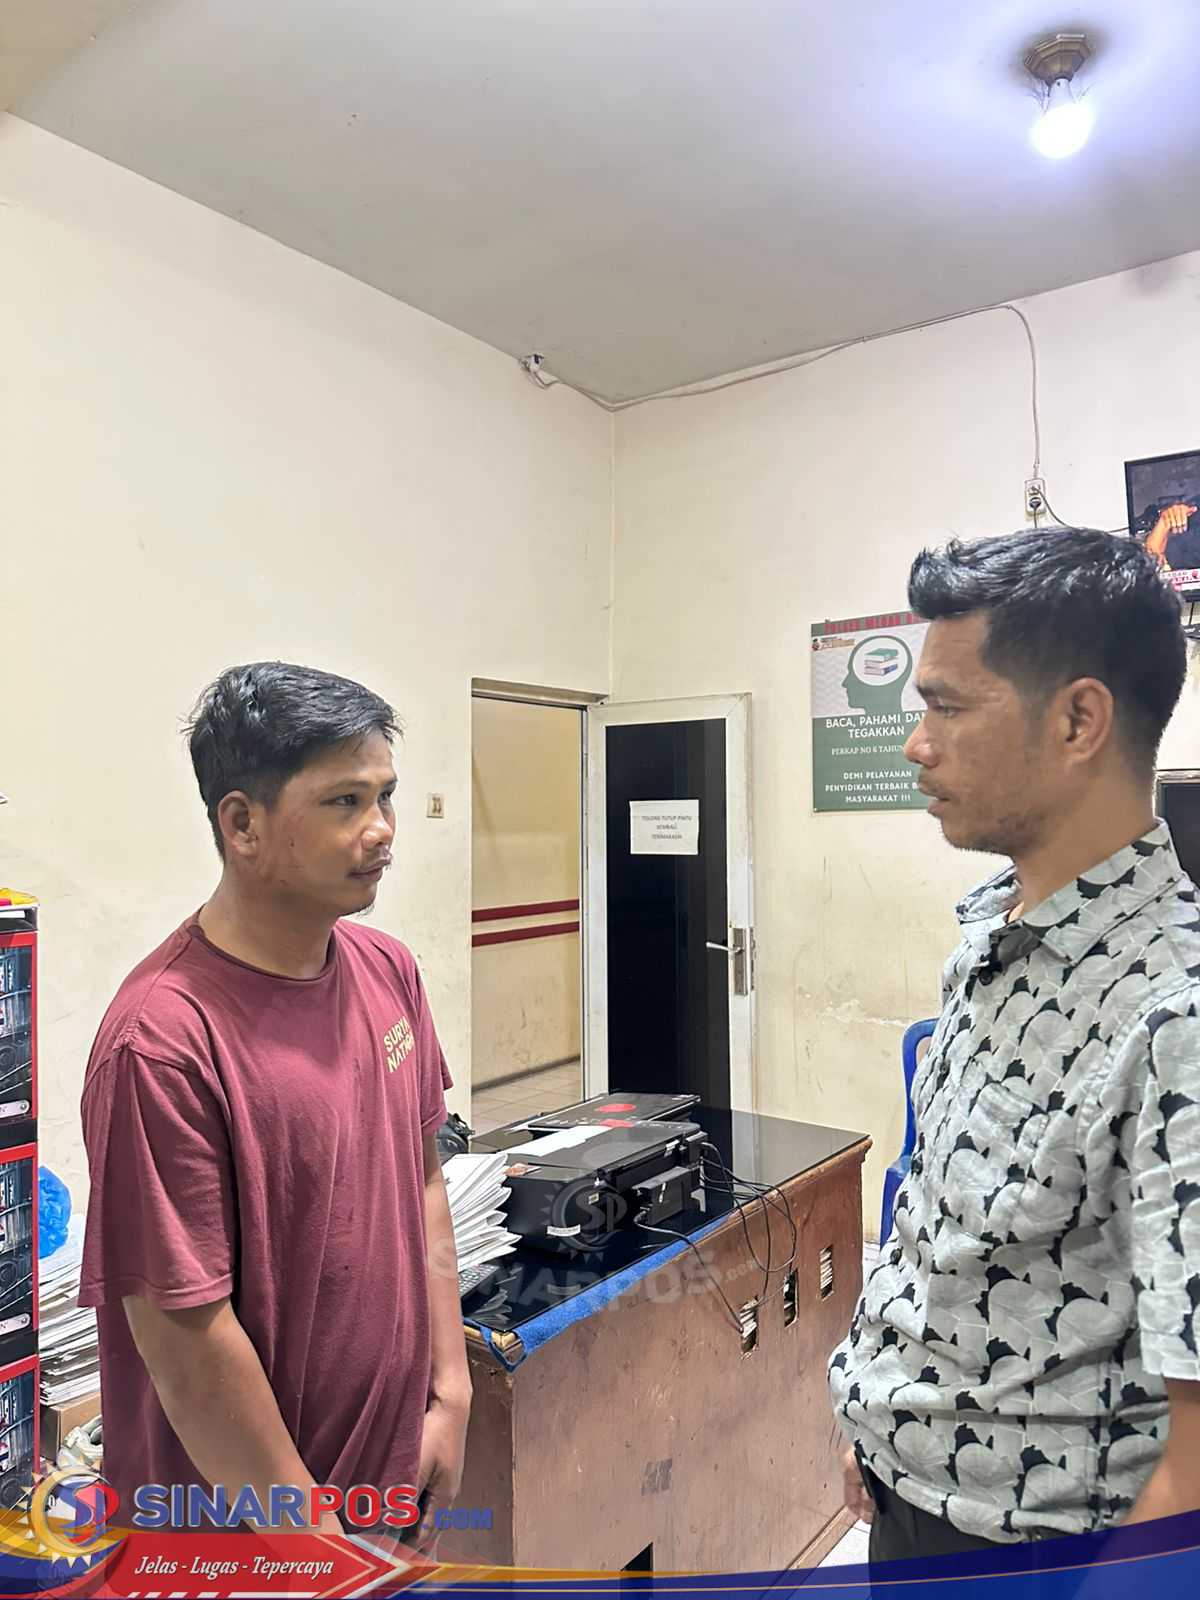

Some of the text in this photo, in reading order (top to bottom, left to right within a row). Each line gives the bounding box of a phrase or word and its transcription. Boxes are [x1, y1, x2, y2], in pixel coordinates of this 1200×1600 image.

[826, 717, 856, 728] BACA,
[860, 713, 900, 725] PAHAMI
[848, 726, 904, 738] TEGAKKAN
[843, 770, 912, 780] DEMI PELAYANAN
[825, 784, 872, 792] PENYIDIKAN
[875, 782, 909, 791] TERBAIK
[845, 795, 898, 803] MASYARAKAT
